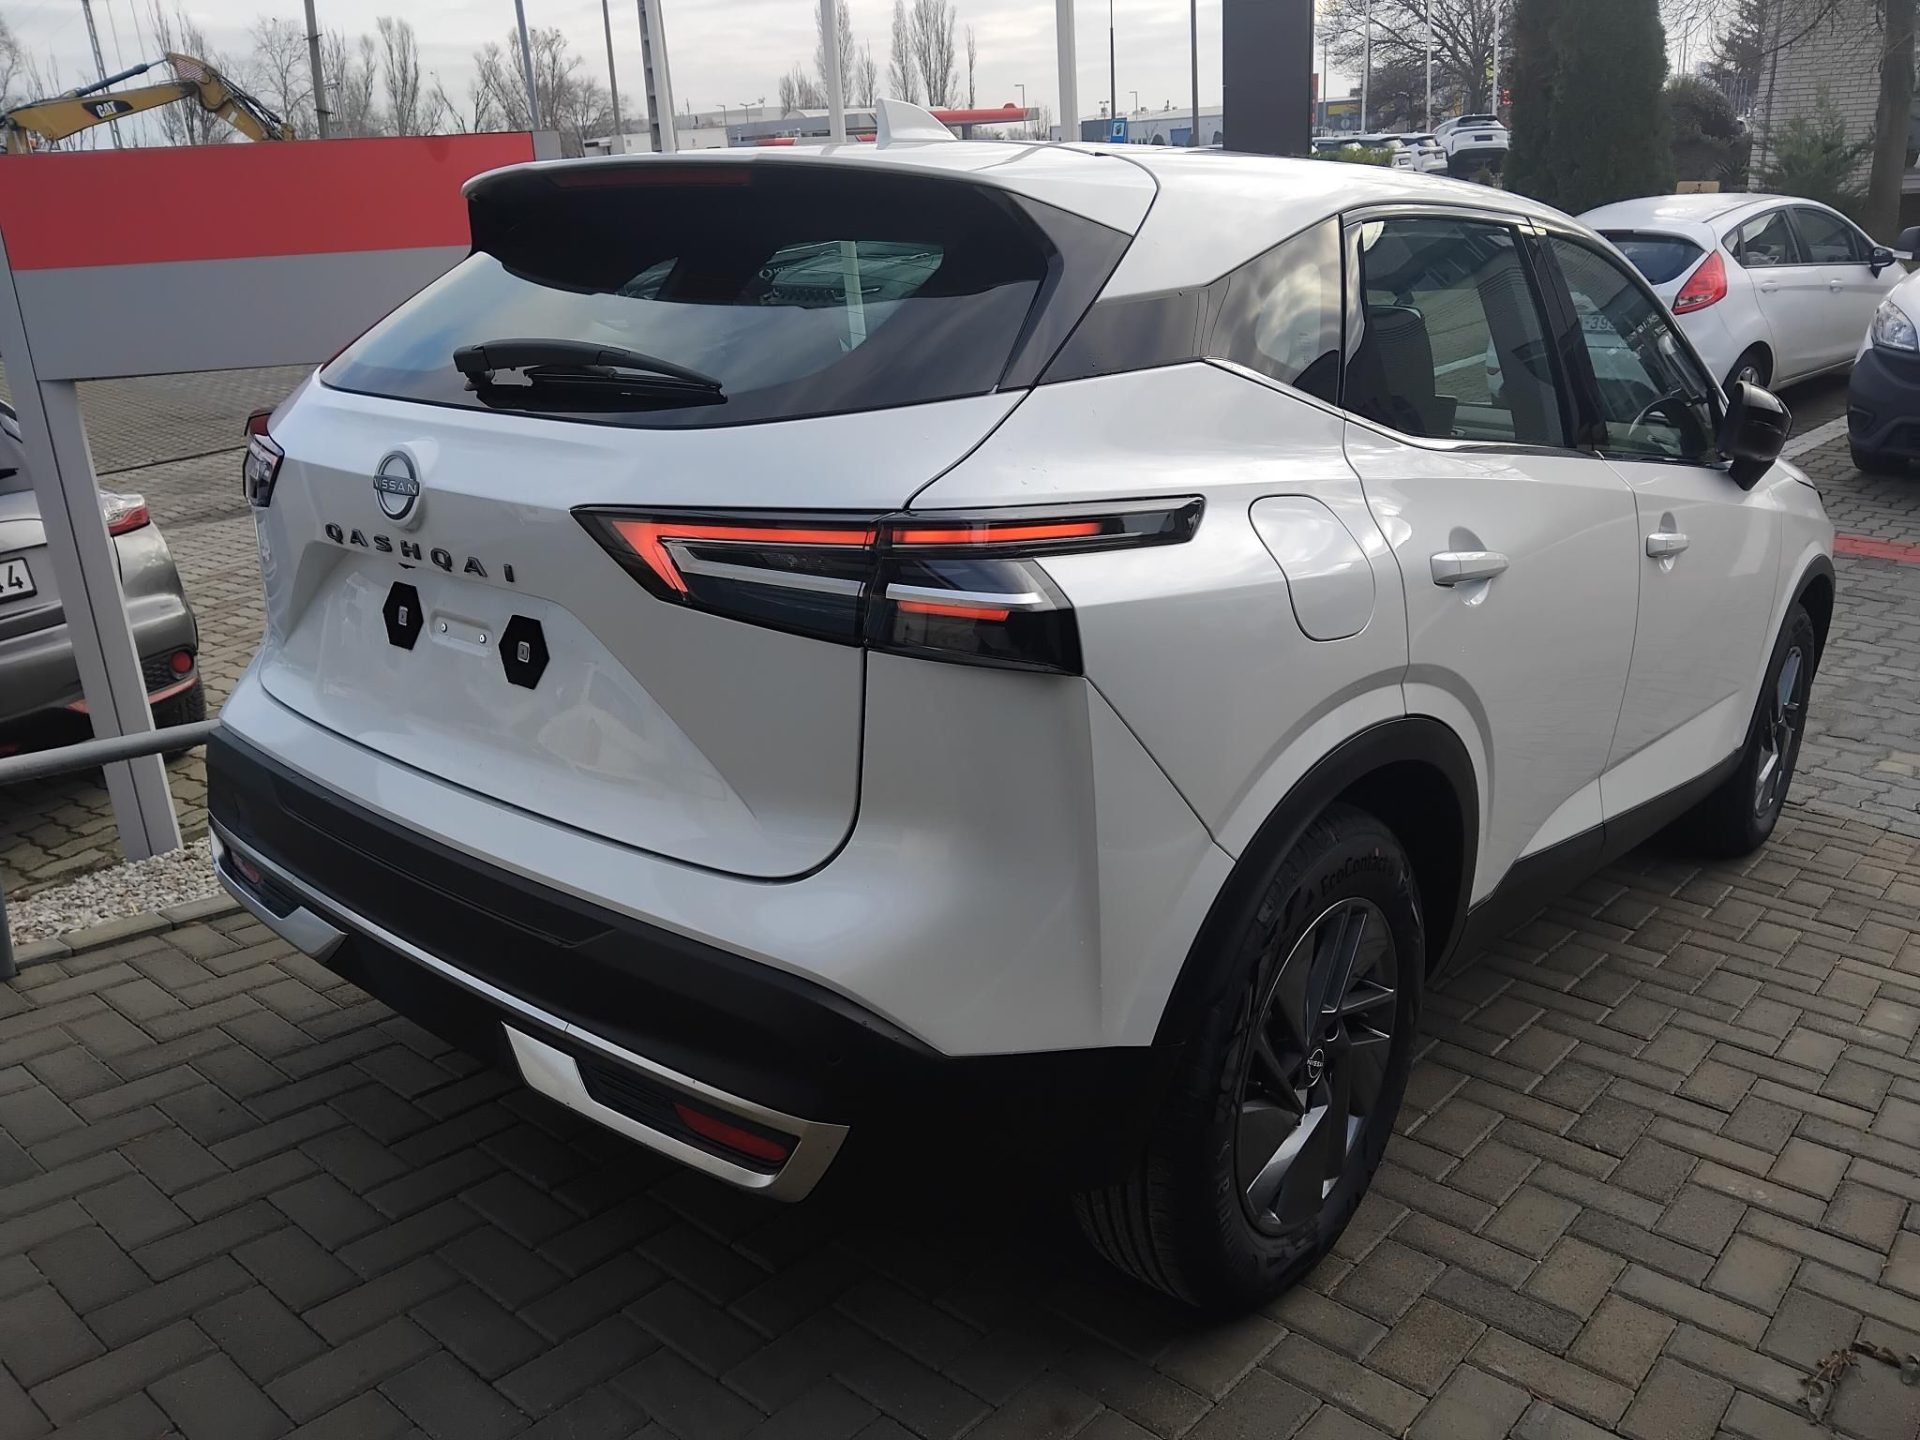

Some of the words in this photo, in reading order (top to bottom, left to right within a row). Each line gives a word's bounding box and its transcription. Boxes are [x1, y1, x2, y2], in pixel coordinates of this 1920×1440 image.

[96, 101, 116, 117] CAT
[325, 522, 514, 583] QASHQAI
[0, 565, 23, 592] 4
